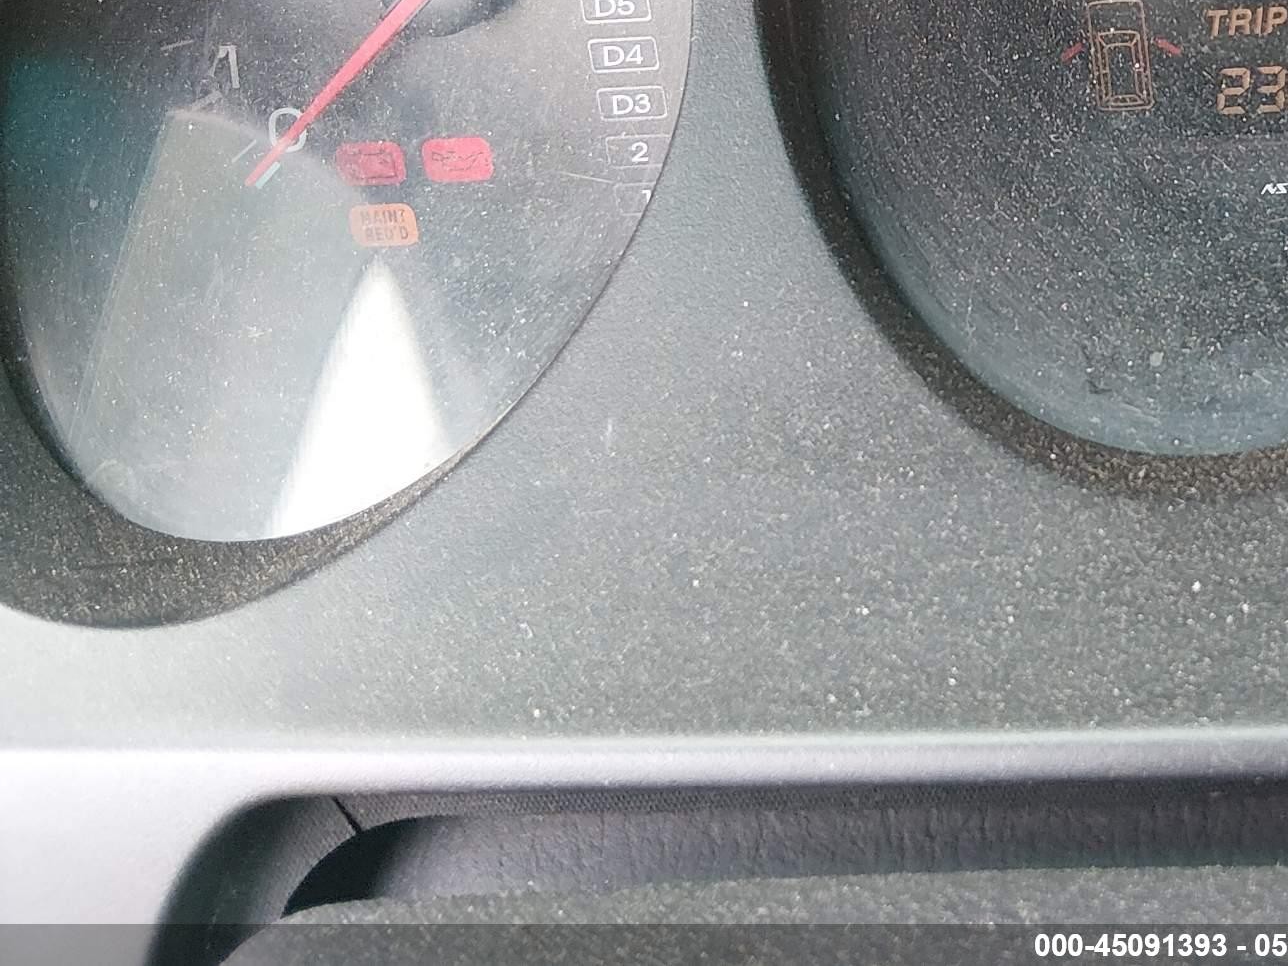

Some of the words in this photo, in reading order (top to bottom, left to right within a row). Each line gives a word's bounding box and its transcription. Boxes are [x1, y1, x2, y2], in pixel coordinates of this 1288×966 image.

[1207, 6, 1288, 37] TRIP
[603, 44, 644, 67] D4
[612, 93, 651, 115] D3
[631, 141, 649, 163] 2
